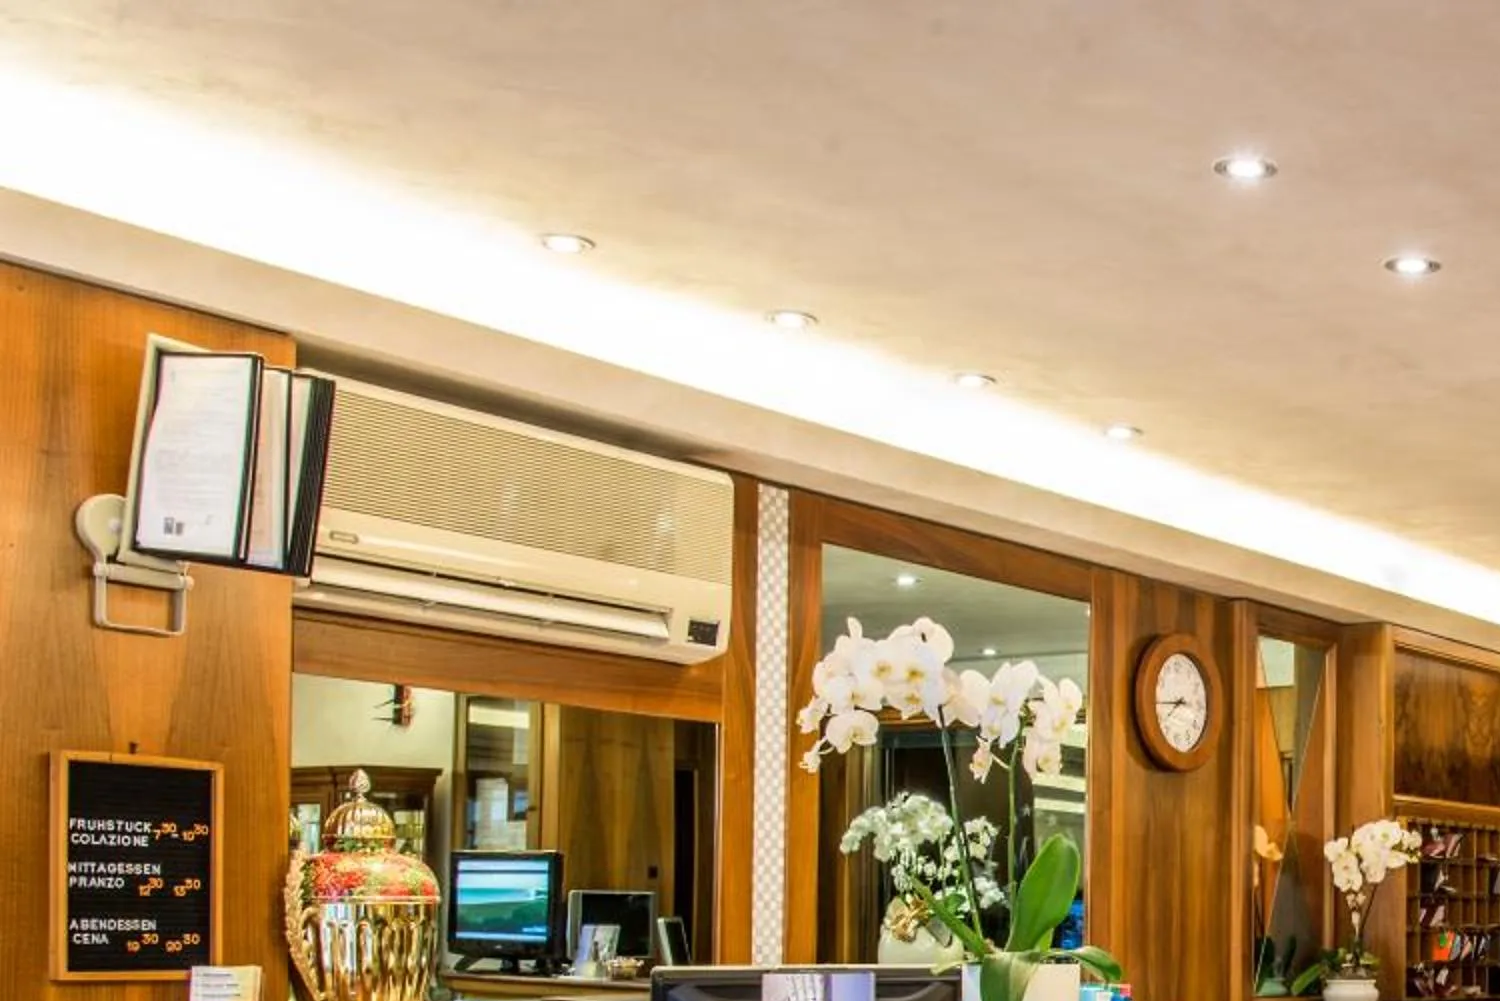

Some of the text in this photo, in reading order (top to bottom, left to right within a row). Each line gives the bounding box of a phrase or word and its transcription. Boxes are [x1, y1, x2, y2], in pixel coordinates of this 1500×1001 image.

[71, 833, 149, 847] COLAZIONE
[69, 876, 125, 889] PRANZO
[69, 919, 156, 931] ABENDESSEN
[73, 933, 109, 944] CENA
